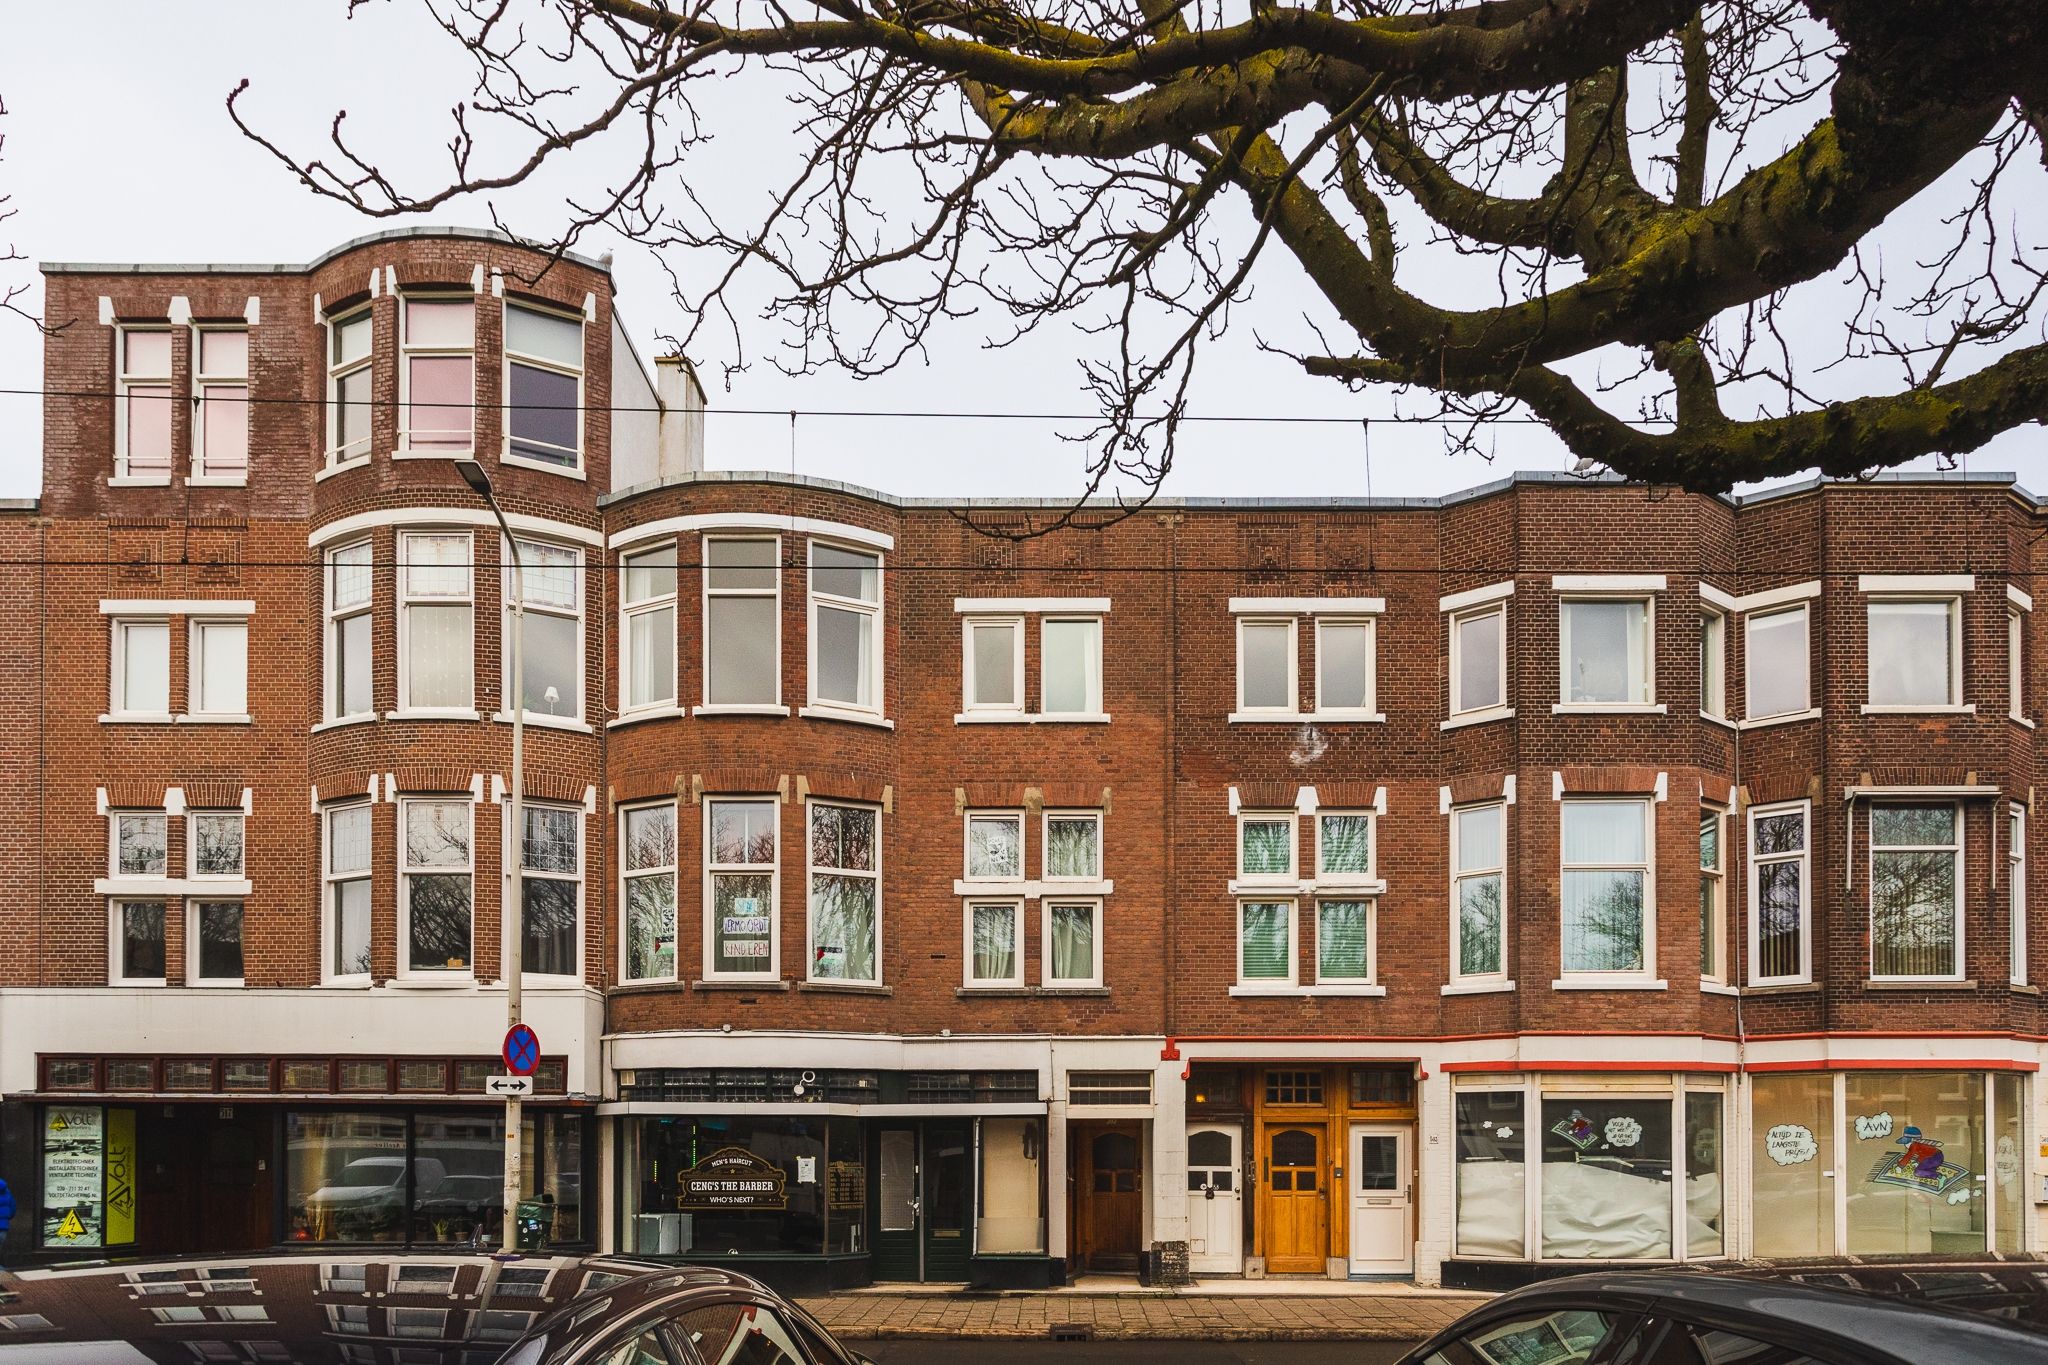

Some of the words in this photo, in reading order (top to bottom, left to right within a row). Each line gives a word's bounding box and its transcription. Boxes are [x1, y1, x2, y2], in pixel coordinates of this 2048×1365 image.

[1863, 1120, 1888, 1131] AVN
[711, 1158, 728, 1167] MEN'S
[109, 1146, 126, 1196] Volt
[691, 1181, 719, 1191] CENG'S
[720, 1181, 738, 1191] THE
[739, 1181, 774, 1191] BARBER
